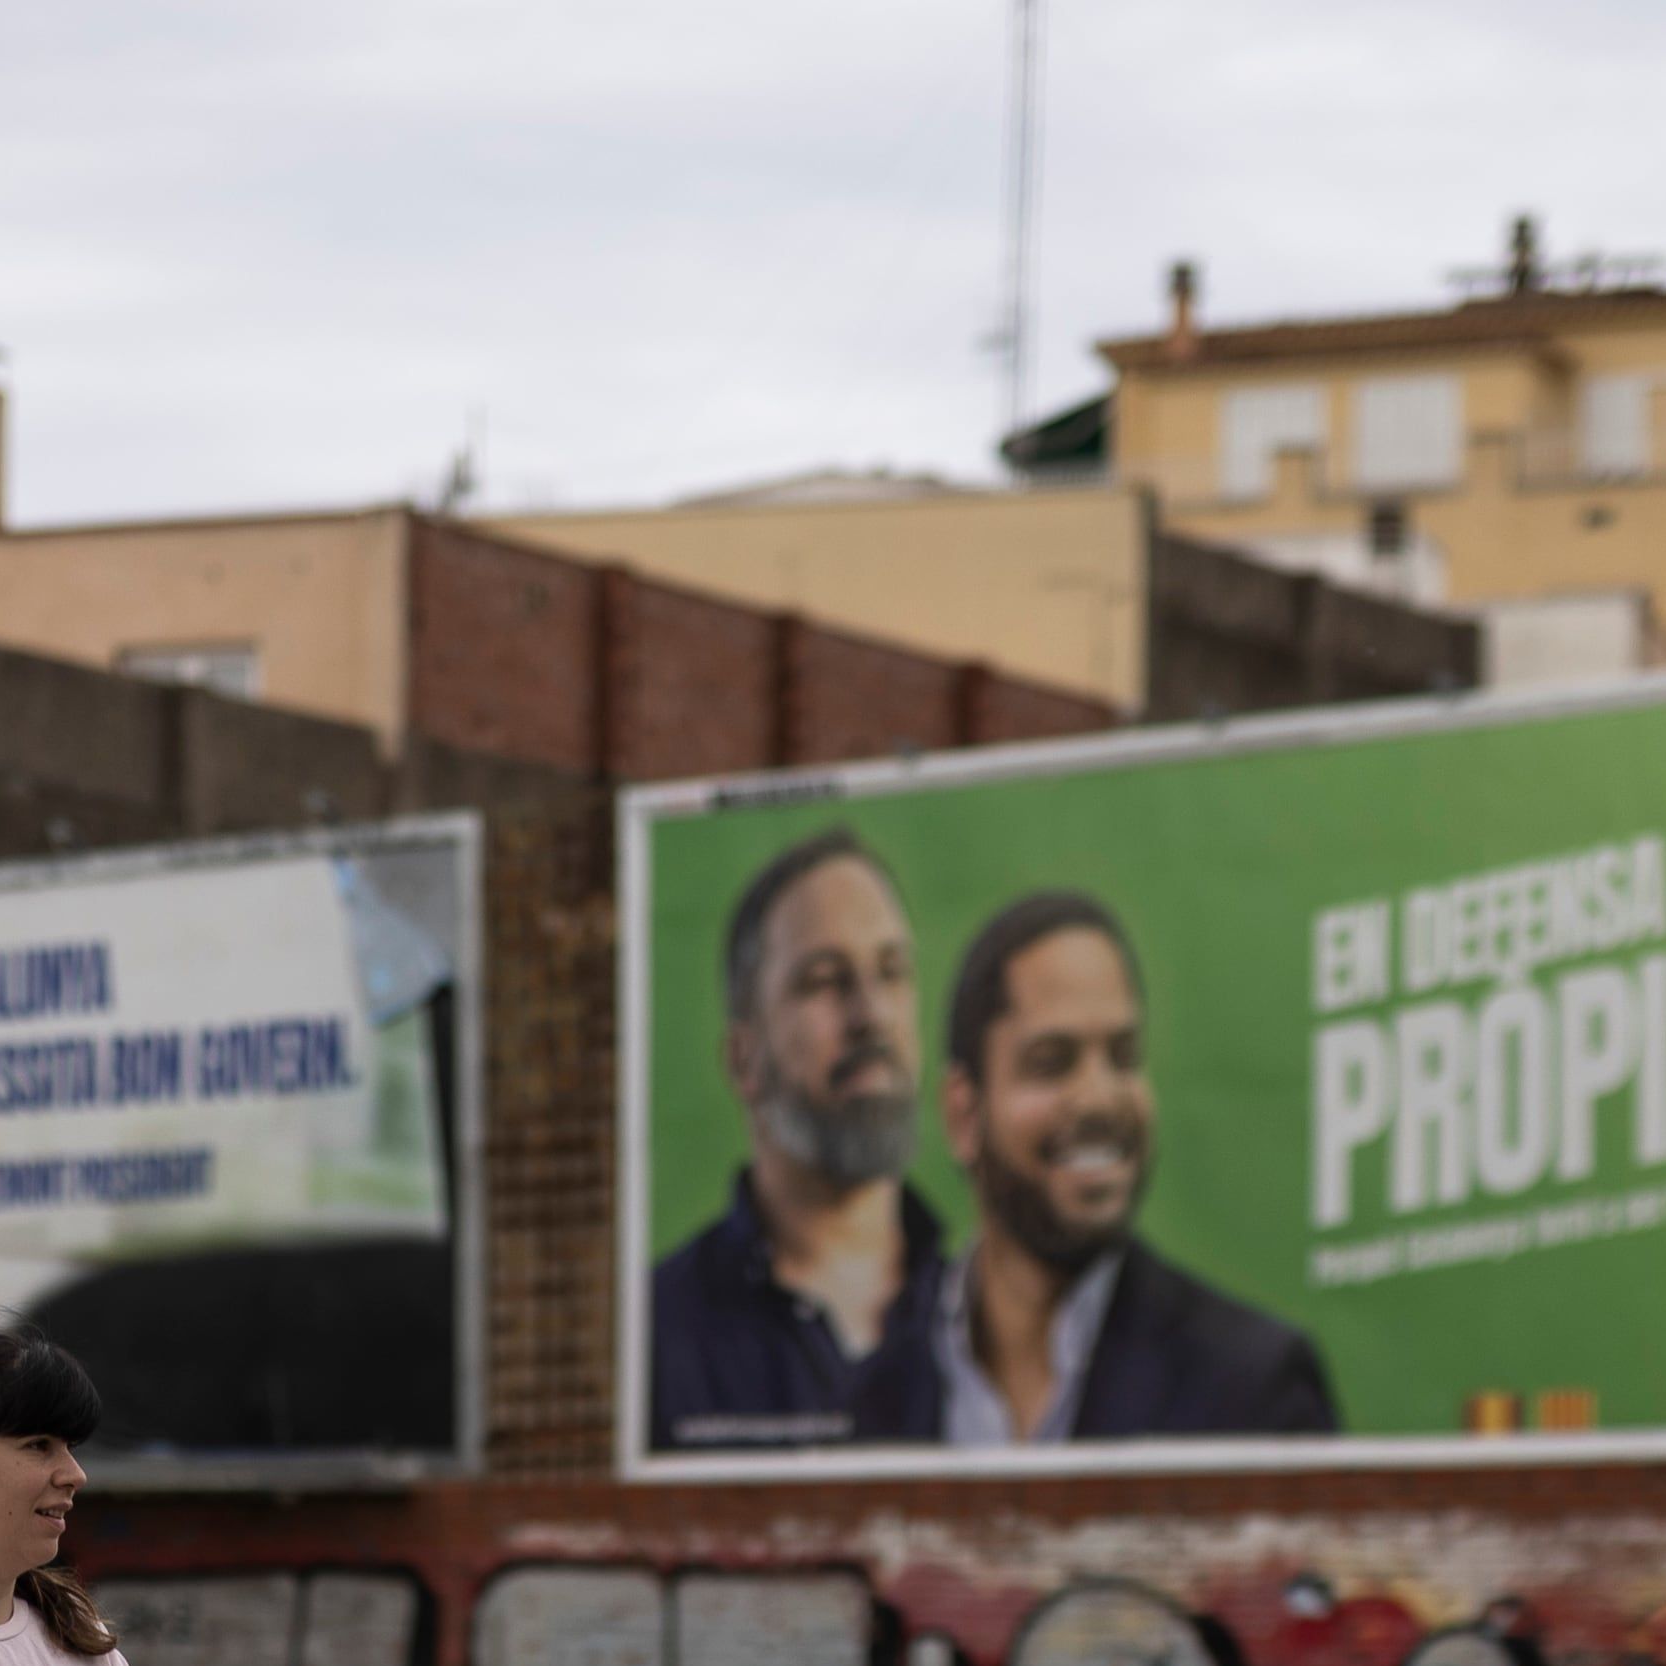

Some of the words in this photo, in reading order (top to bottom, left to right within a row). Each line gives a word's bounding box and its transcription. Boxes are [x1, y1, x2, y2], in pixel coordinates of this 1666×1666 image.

[1313, 900, 1391, 1012] EN
[1404, 834, 1666, 993] DEFENSA
[110, 1032, 182, 1102] BON
